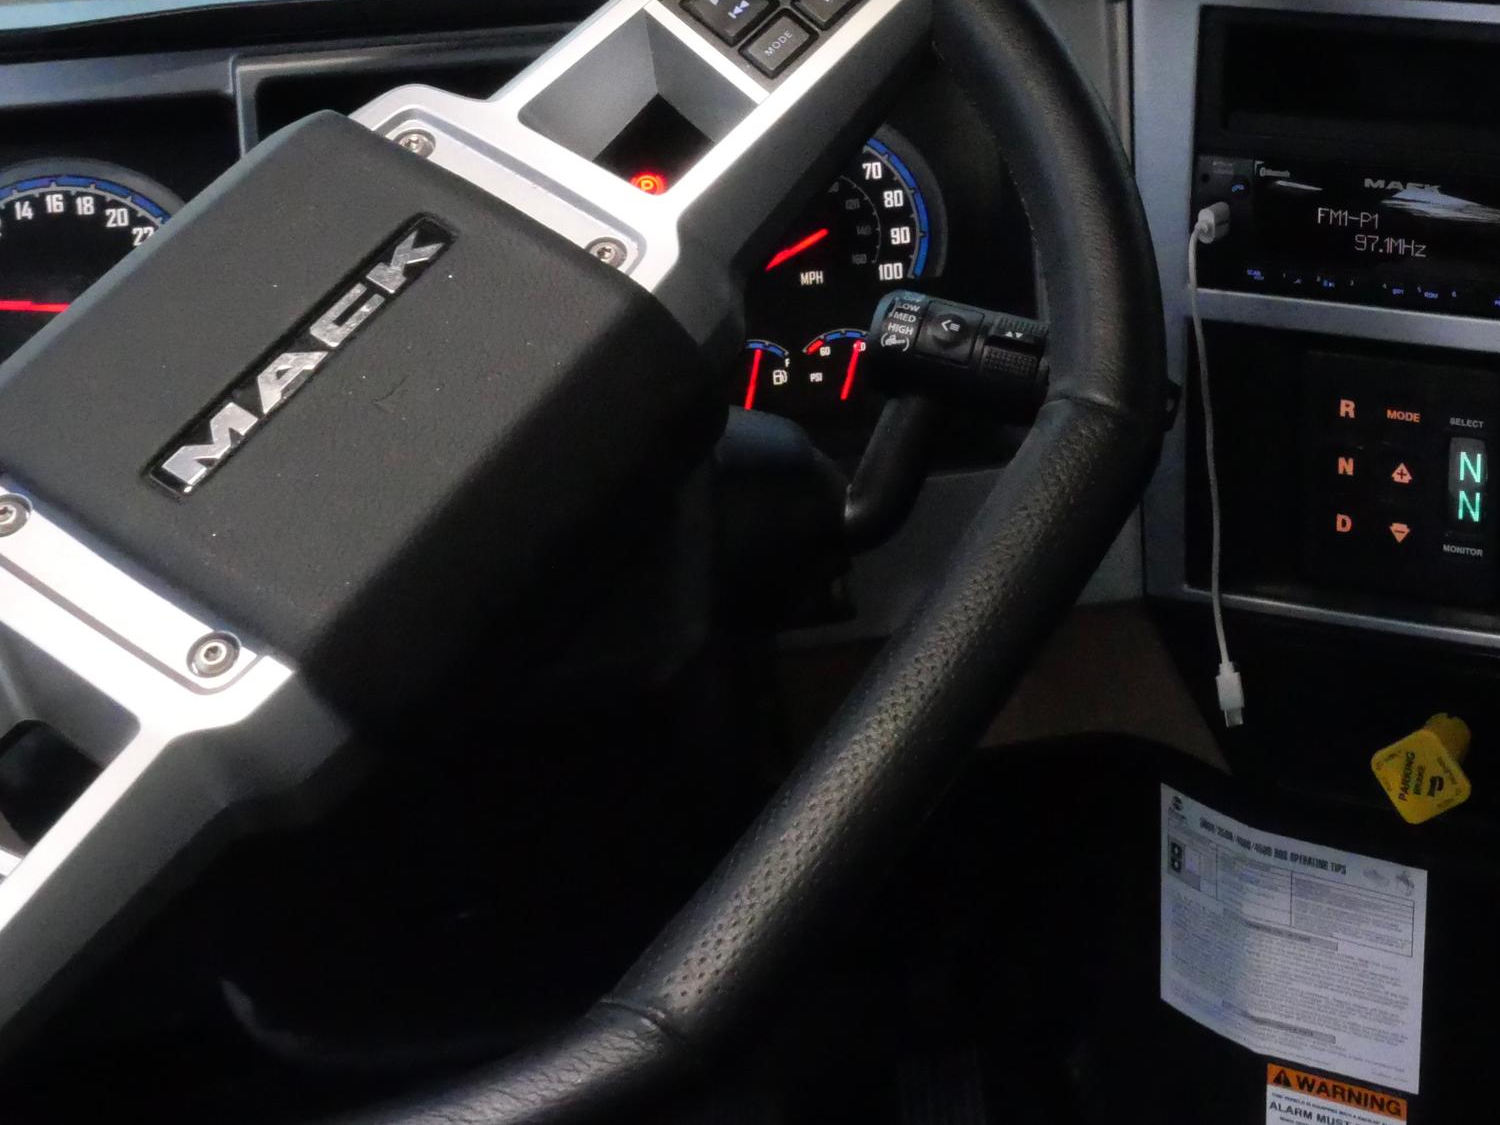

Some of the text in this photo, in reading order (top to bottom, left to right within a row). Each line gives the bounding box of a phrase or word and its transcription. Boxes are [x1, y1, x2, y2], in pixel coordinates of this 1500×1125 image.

[764, 29, 793, 57] MODE
[862, 162, 882, 180] 70
[45, 193, 64, 213] 16
[75, 196, 95, 215] 18
[883, 190, 904, 208] 80
[14, 200, 33, 220] 14
[105, 207, 129, 228] 20
[1316, 206, 1380, 229] FM1-P1
[890, 226, 911, 245] 90
[800, 270, 824, 286] MPH
[878, 262, 904, 281] 100
[897, 301, 921, 313] LOW
[894, 311, 917, 324] MED
[887, 322, 914, 336] HIGH
[162, 230, 446, 486] MACK
[1339, 398, 1356, 419] R
[1387, 409, 1420, 423] MODE
[1449, 417, 1485, 428] SELECT
[1337, 457, 1354, 476] N
[1459, 451, 1482, 483] N
[1458, 490, 1481, 522] N
[1336, 513, 1352, 533] D
[1442, 543, 1484, 557] MONITOR
[1398, 751, 1416, 802] PARKING
[1296, 1074, 1402, 1117] WARNING
[1269, 1101, 1312, 1120] ALARM
